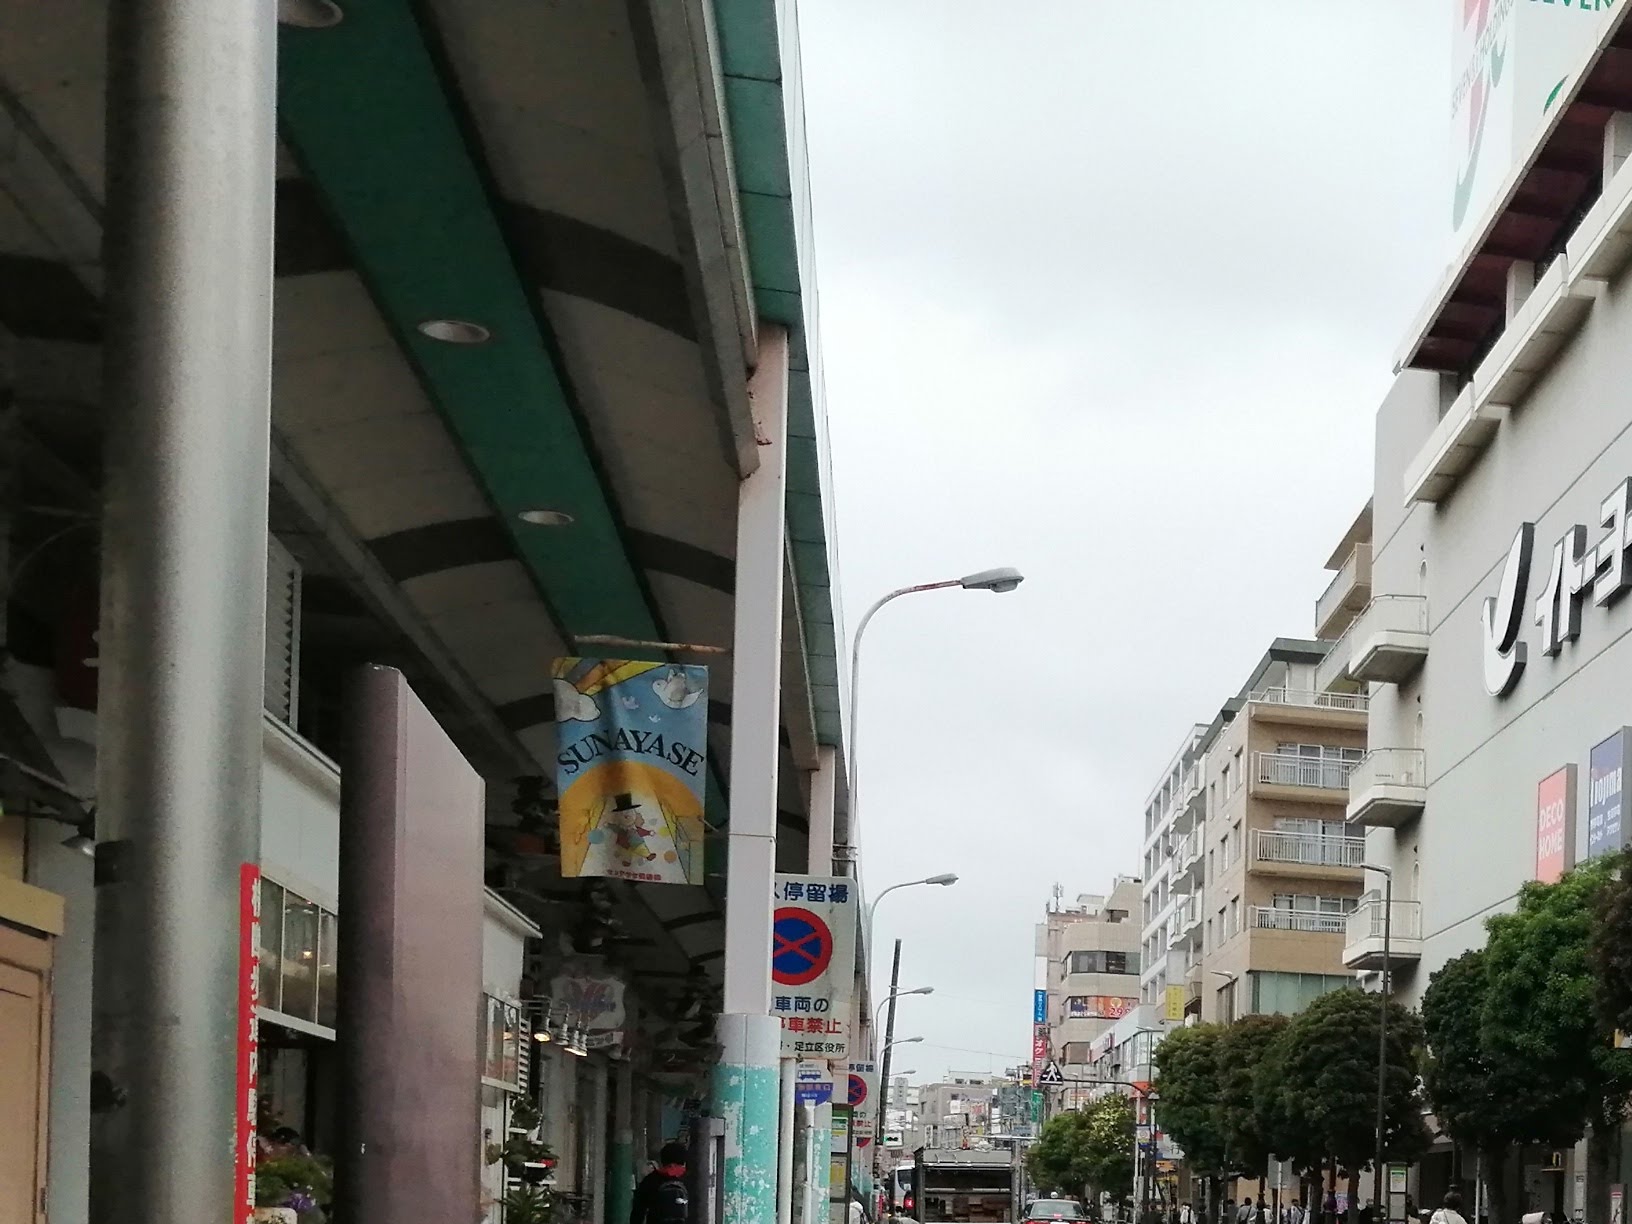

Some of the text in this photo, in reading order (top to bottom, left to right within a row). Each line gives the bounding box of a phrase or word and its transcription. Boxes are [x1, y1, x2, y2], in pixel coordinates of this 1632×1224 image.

[557, 728, 705, 777] SUNAYASE
[1540, 798, 1563, 830] DECO
[1539, 831, 1563, 860] HOME
[775, 995, 829, 1013] 車両の
[780, 1040, 846, 1055] ・足立区役所
